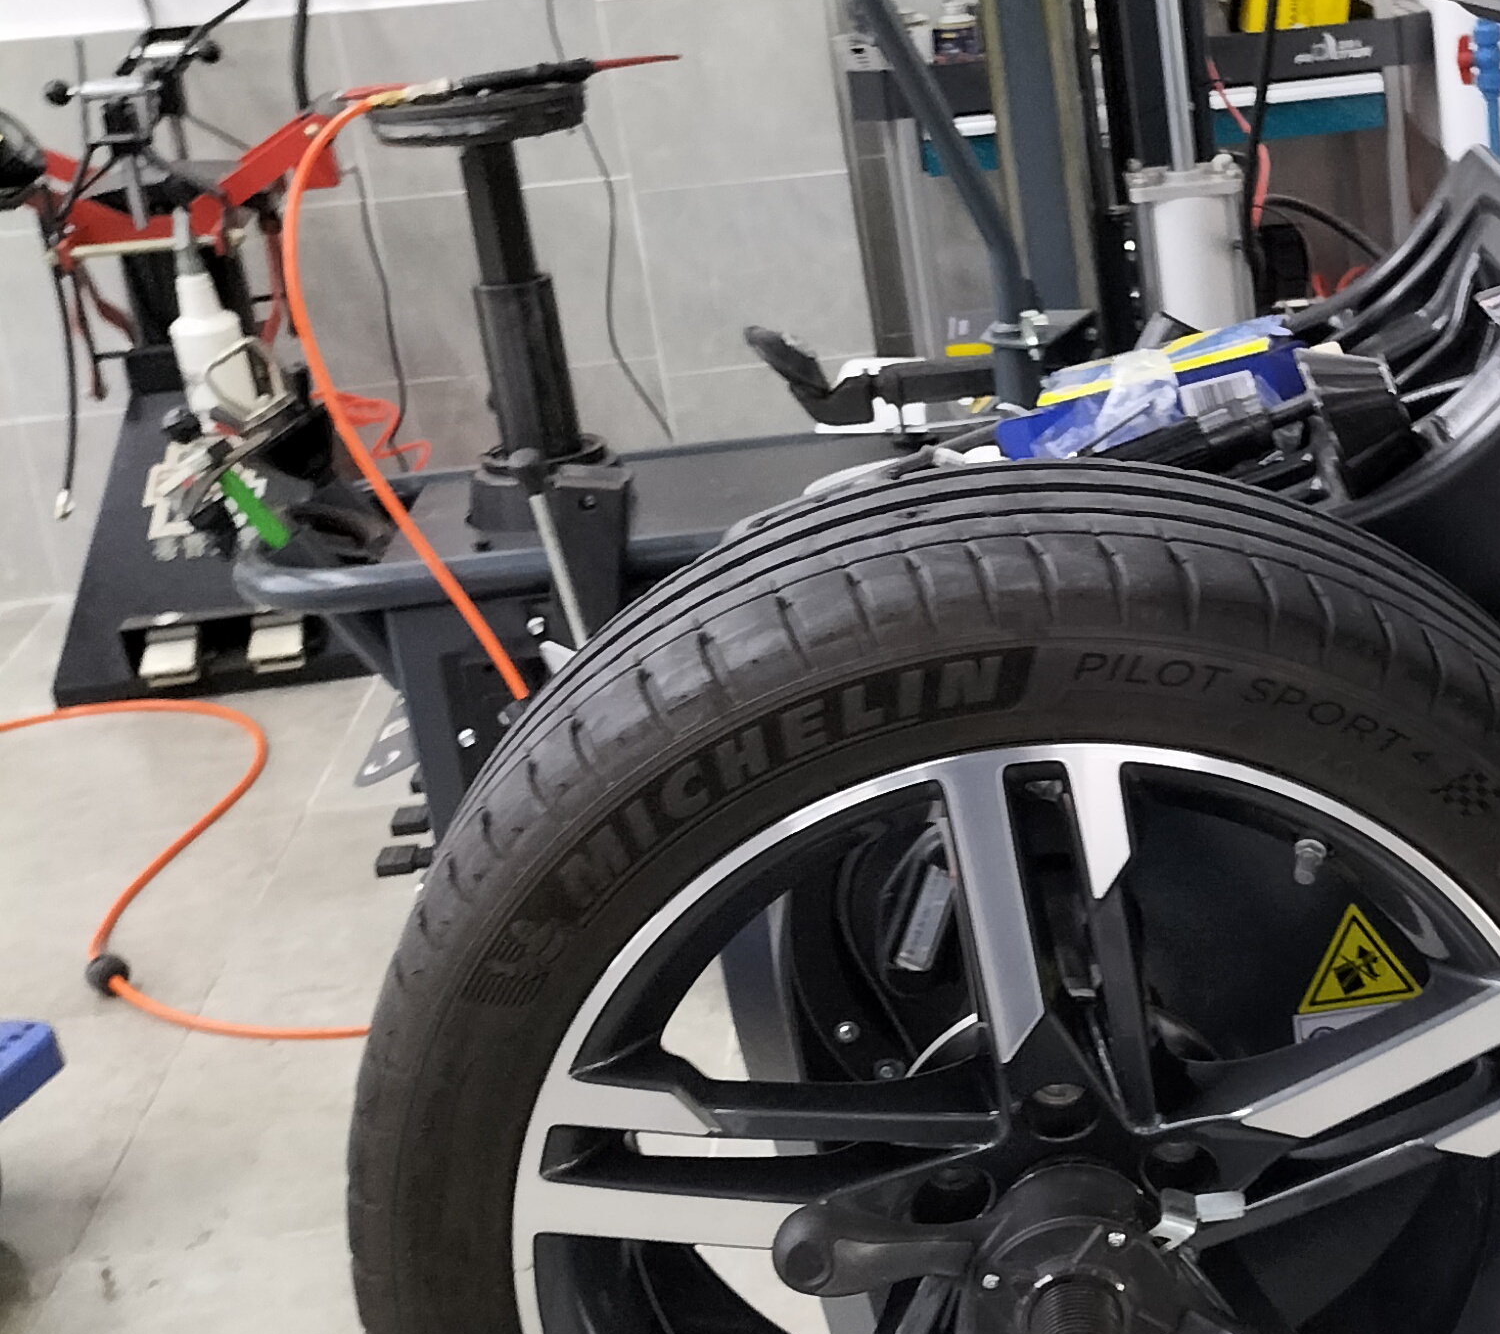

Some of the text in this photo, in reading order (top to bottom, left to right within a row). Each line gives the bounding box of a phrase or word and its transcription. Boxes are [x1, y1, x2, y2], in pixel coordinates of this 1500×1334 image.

[556, 654, 1005, 909] MICHELIN
[1072, 651, 1234, 693] PILOT
[1240, 676, 1411, 751] SPORT
